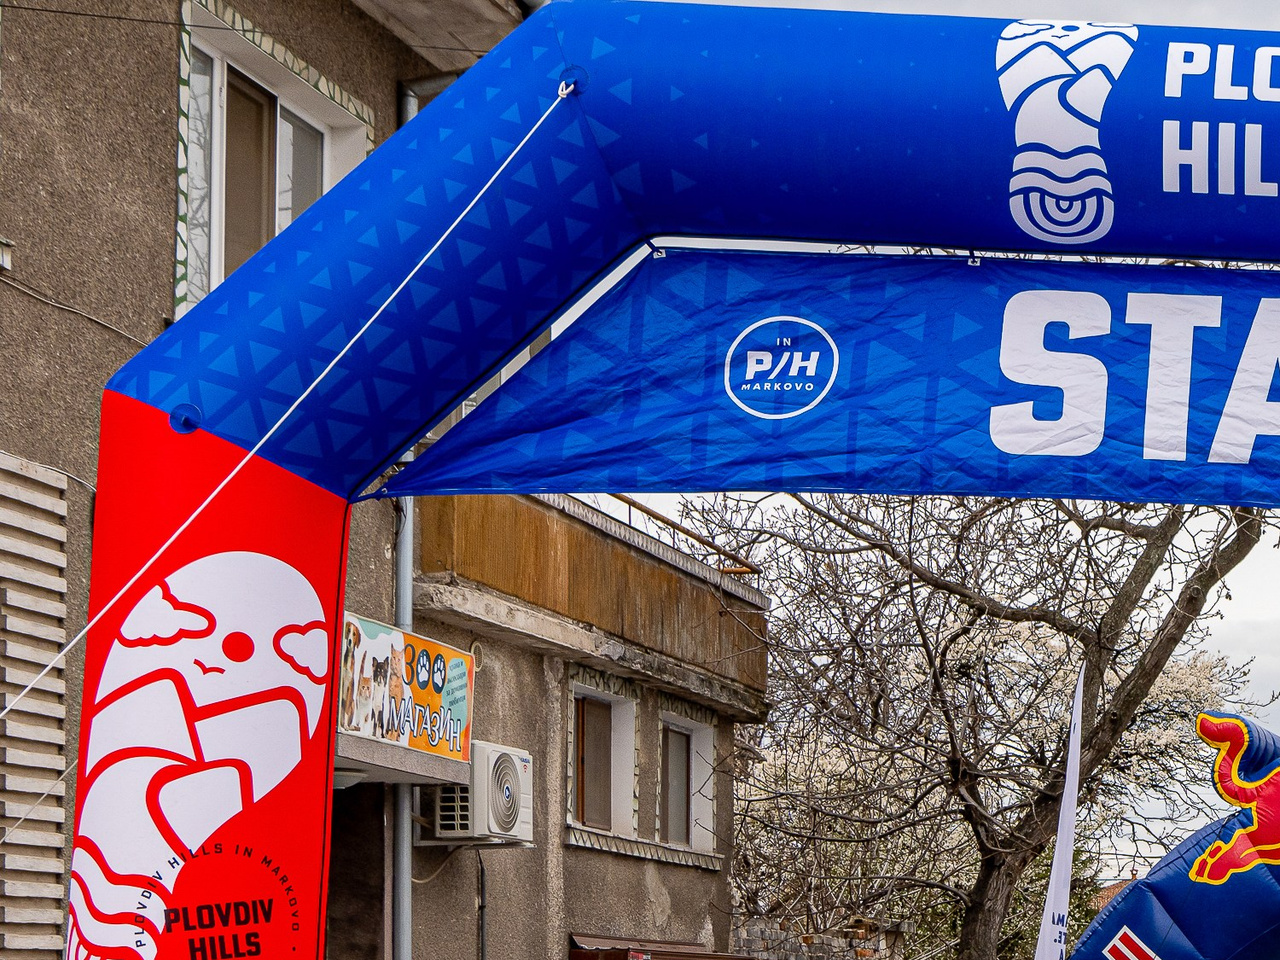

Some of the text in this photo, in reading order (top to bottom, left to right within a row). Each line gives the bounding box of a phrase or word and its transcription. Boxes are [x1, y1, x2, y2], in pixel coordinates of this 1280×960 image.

[776, 337, 791, 346] IN
[745, 350, 820, 380] P/H
[741, 382, 814, 391] MARKOVO
[388, 696, 462, 752] МАГАЗИН
[134, 843, 299, 948] PLOVDIV HILLS IN MARKOVO
[164, 898, 273, 934] PLOVDIV
